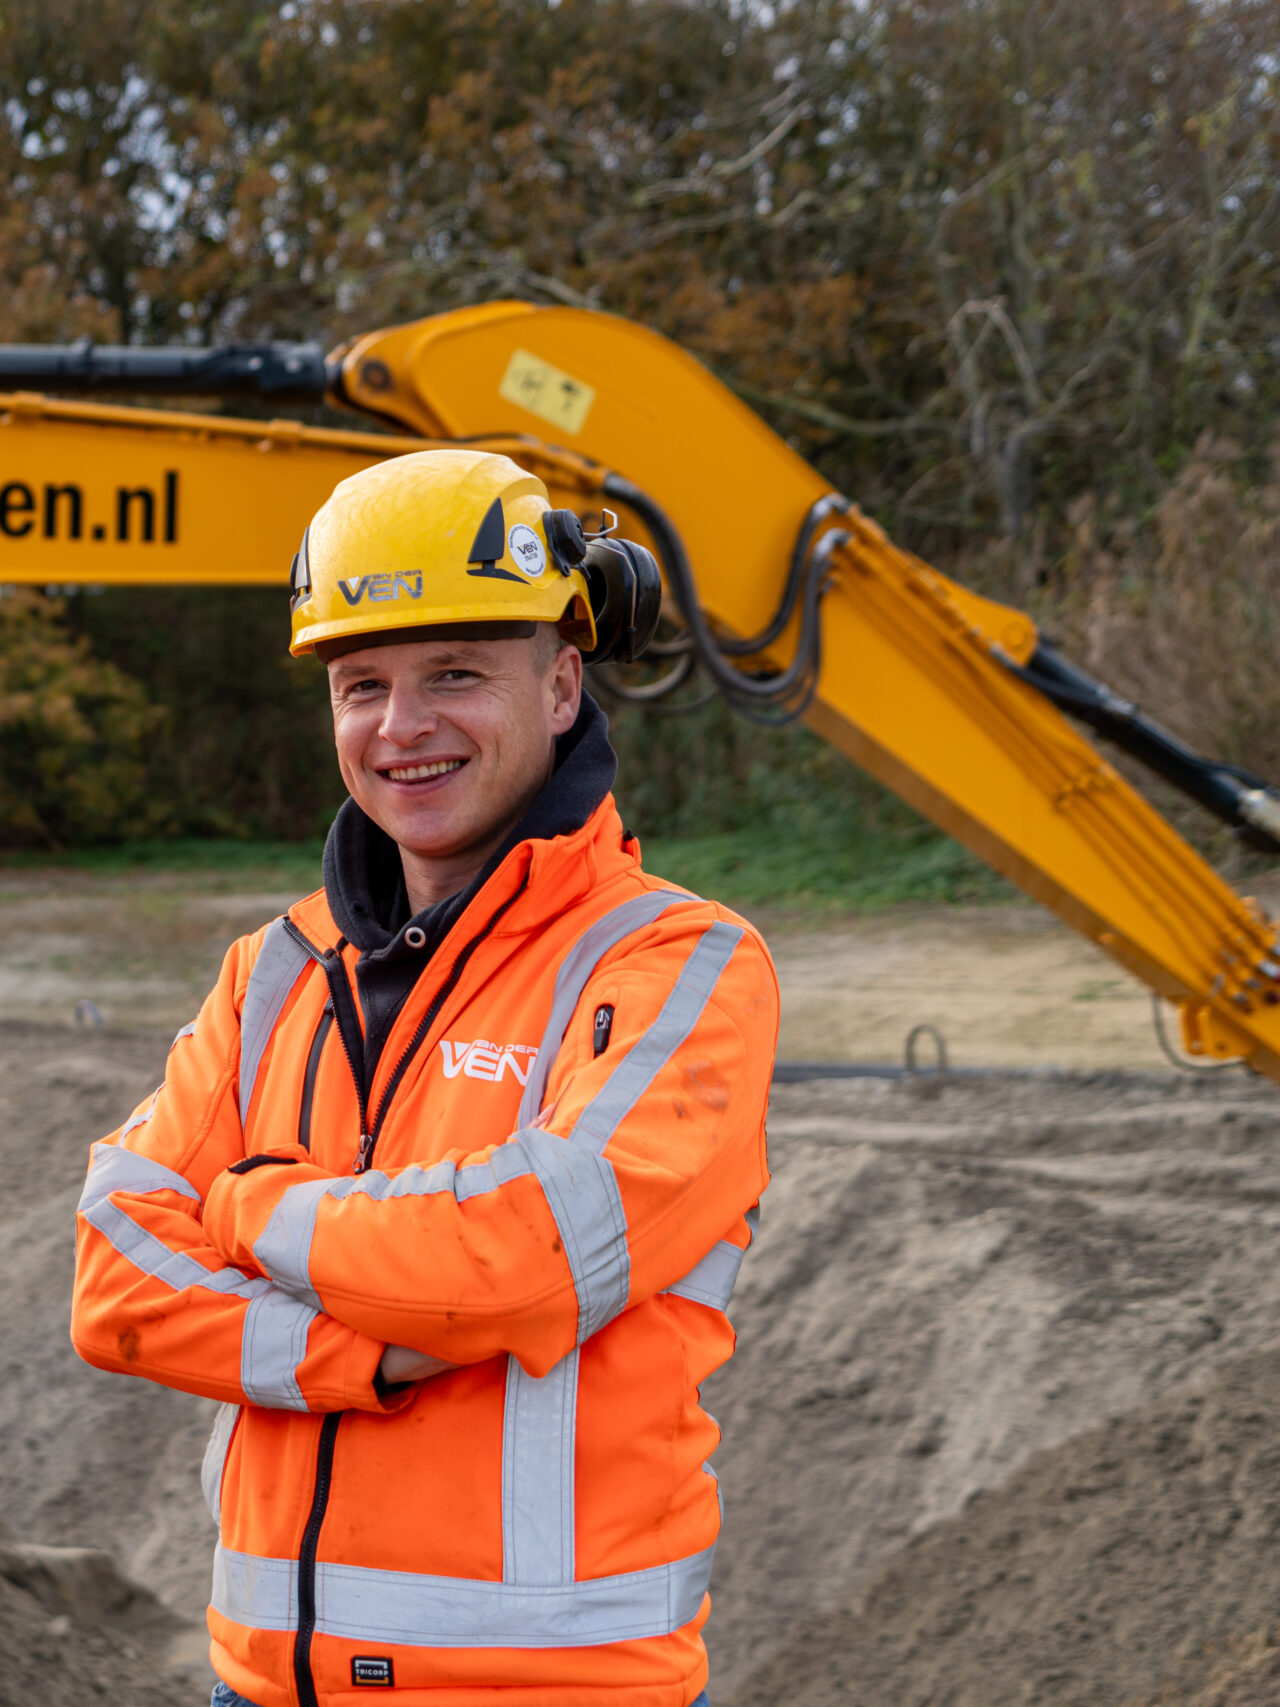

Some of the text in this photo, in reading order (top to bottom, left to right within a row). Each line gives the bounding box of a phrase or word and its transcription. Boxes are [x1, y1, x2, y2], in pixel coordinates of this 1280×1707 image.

[337, 575, 423, 606] VEN
[439, 1040, 537, 1087] VEN
[356, 1668, 389, 1676] TRICORP
